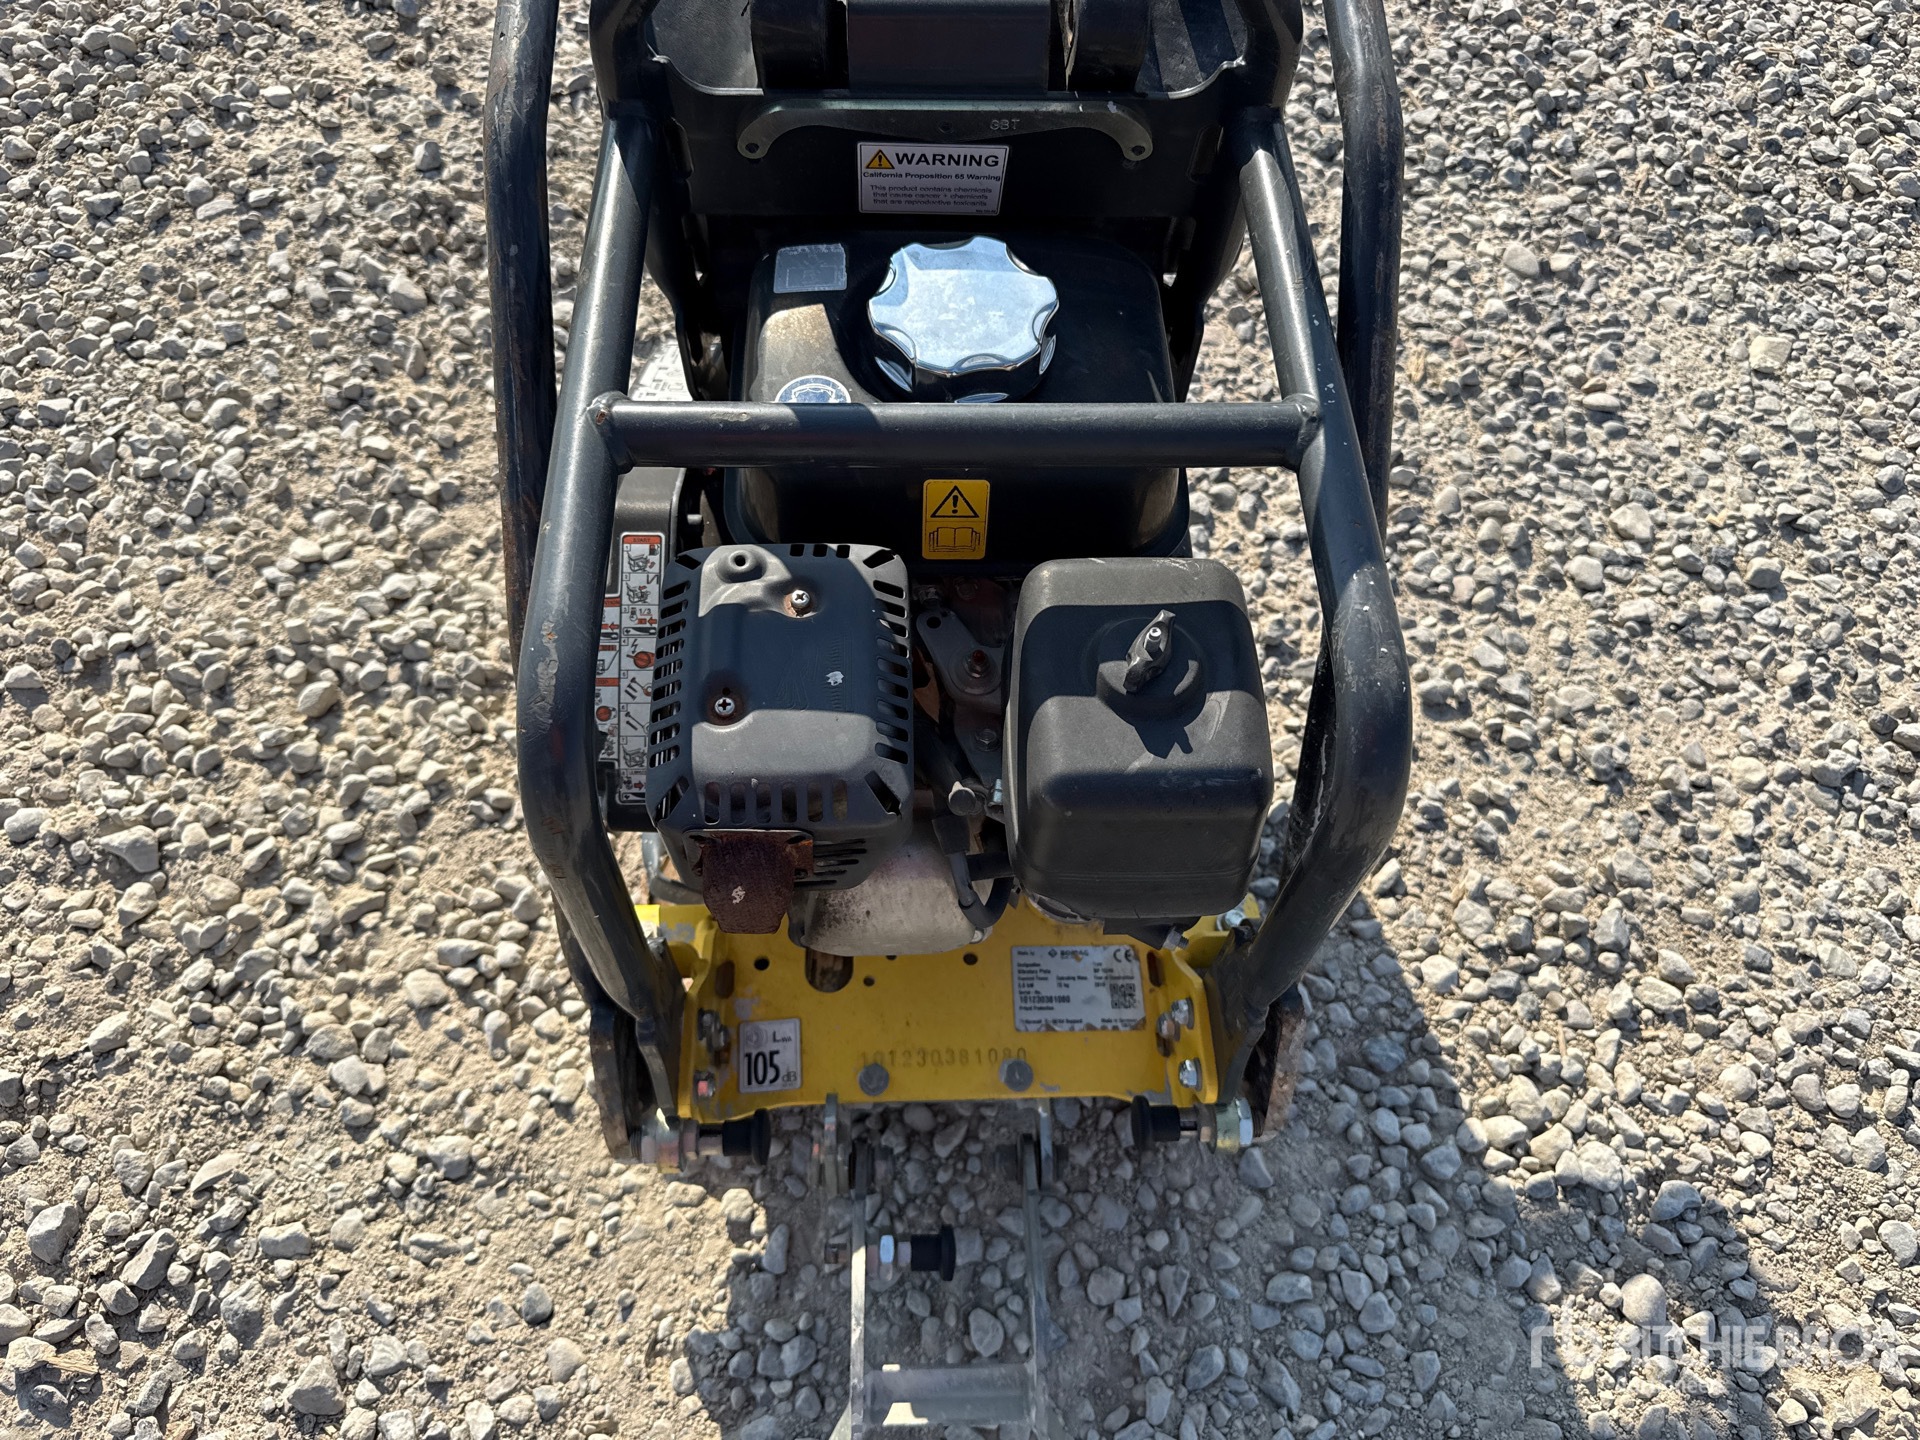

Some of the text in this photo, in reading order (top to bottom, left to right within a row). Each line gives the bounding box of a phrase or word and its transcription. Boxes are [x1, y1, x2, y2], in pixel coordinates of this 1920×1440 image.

[895, 152, 999, 168] WARNING
[905, 172, 952, 180] Proposition
[966, 174, 1001, 182] Warning
[888, 185, 918, 193] product
[953, 186, 993, 194] chemicals
[745, 1050, 780, 1086] 105
[782, 1066, 797, 1082] dB
